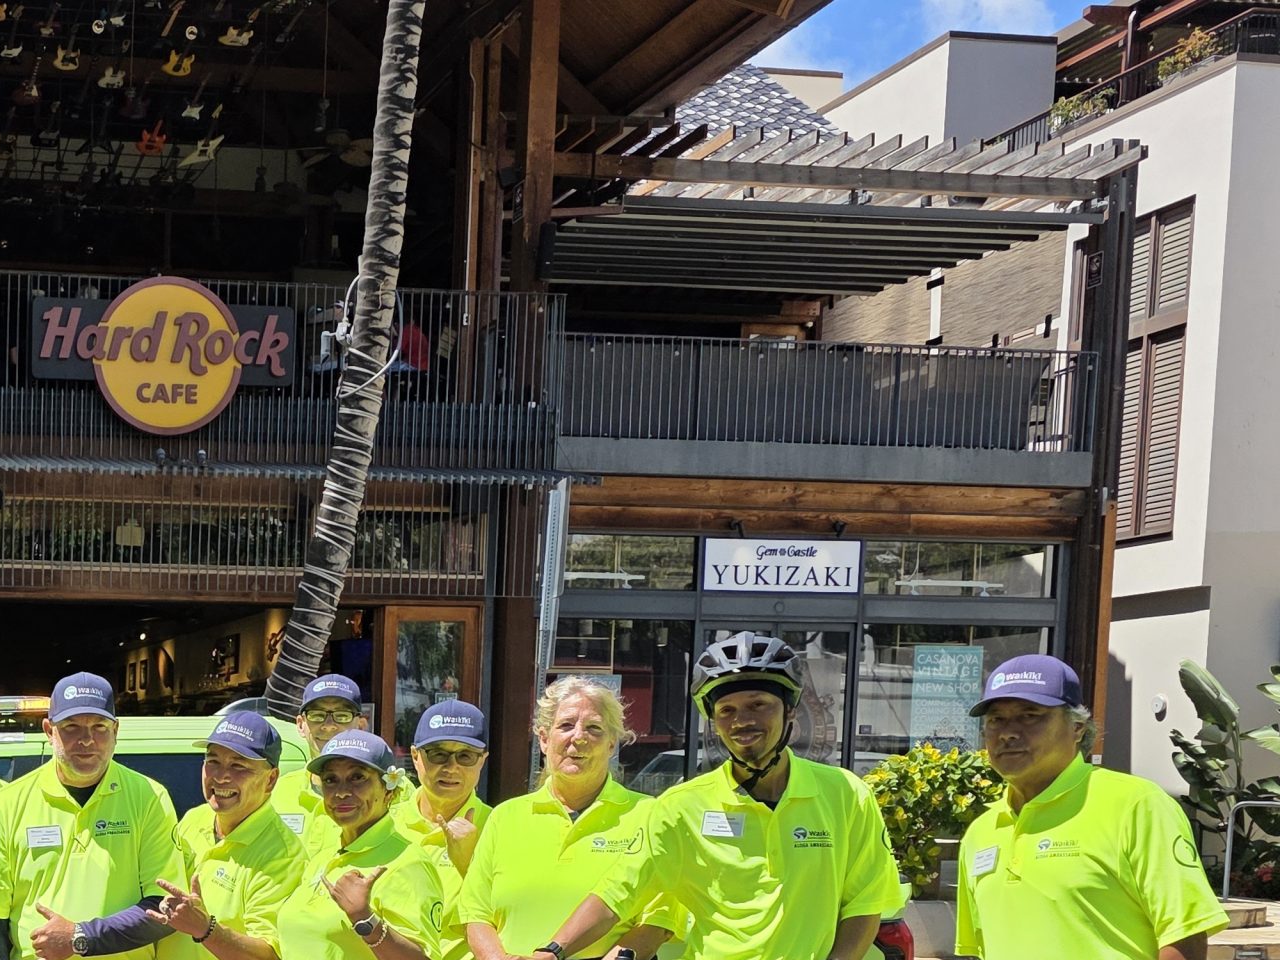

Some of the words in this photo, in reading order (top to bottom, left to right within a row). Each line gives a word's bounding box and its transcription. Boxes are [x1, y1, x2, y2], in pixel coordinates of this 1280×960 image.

[39, 306, 168, 362] Hard
[170, 311, 289, 377] Rock
[136, 382, 198, 404] CAFE
[756, 545, 778, 560] Gem
[787, 545, 818, 558] Castle
[712, 564, 853, 587] YUKIZAKI
[917, 654, 979, 664] CASANOVA
[918, 666, 979, 677] VINTAGE
[916, 683, 944, 693] NEW
[947, 683, 978, 693] SHOP
